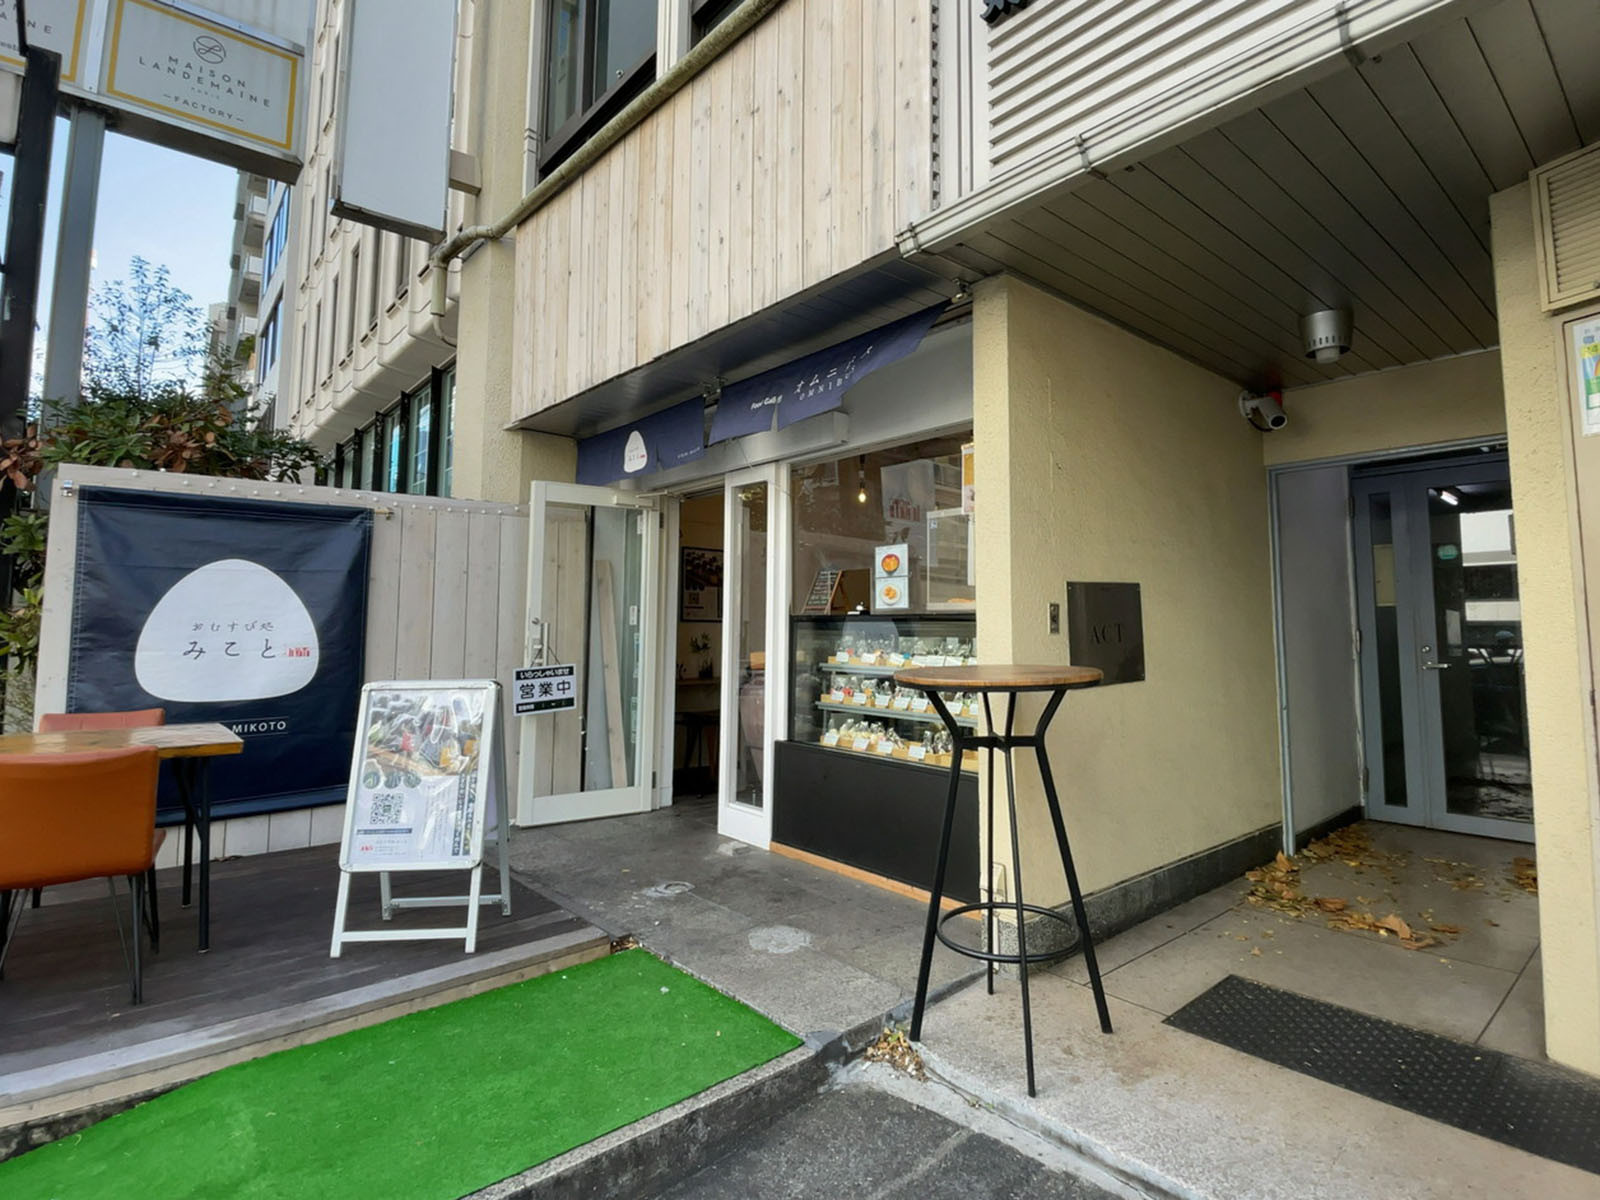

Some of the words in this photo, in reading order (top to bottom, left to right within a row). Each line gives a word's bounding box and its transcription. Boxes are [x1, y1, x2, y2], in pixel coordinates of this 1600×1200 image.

[139, 56, 271, 107] LANDEMAINE
[168, 56, 246, 88] MAISON
[174, 95, 233, 120] FACTORY
[182, 638, 276, 660] みこと
[519, 680, 571, 699] 営業中
[232, 720, 287, 733] MIKOTO
